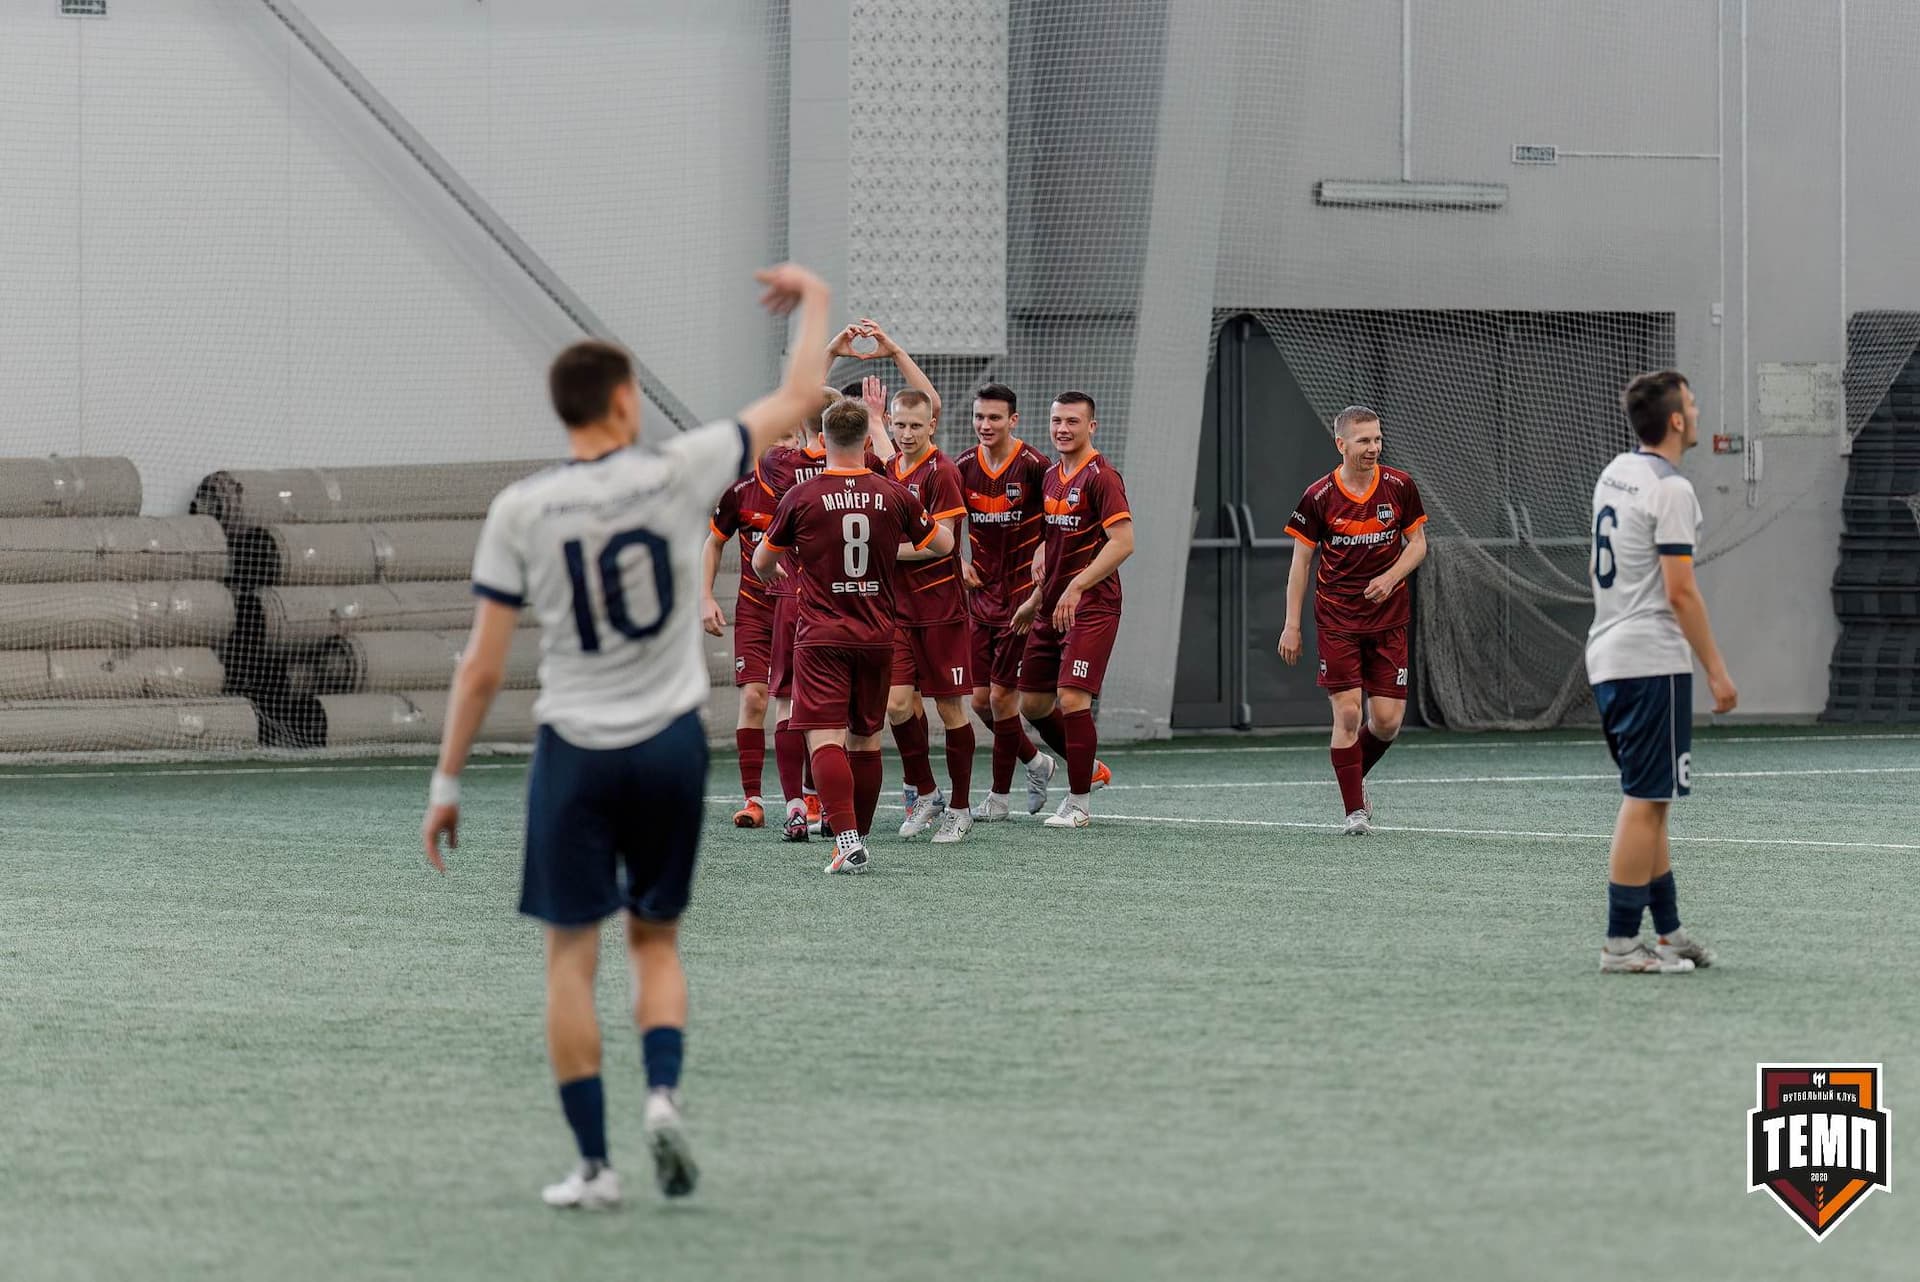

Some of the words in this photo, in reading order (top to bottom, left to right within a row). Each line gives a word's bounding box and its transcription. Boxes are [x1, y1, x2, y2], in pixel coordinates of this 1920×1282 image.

[821, 489, 870, 512] МАЙЕР
[874, 493, 887, 512] А.
[842, 513, 870, 578] 8
[1594, 505, 1618, 589] 6
[563, 528, 674, 653] 10
[831, 581, 879, 593] SEUS
[952, 667, 964, 685] 17
[1072, 660, 1089, 678] 55
